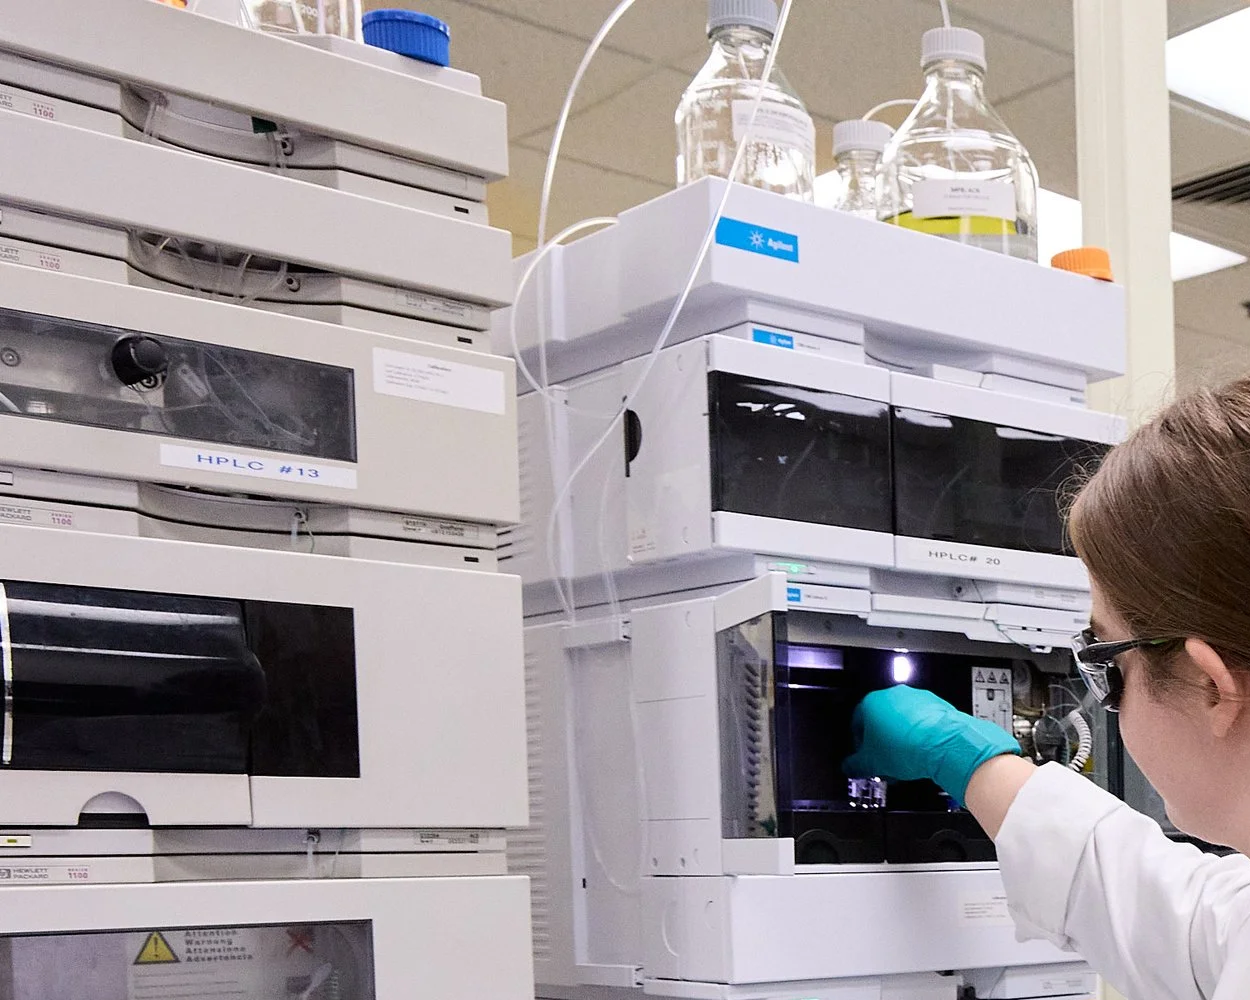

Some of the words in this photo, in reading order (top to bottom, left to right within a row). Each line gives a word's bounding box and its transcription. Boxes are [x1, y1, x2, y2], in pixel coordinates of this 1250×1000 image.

[33, 107, 54, 118] 1100
[197, 454, 264, 471] HPLC
[279, 465, 319, 478] #13
[51, 517, 72, 525] 1100
[928, 551, 977, 562] HPLC#
[985, 557, 1000, 565] 20
